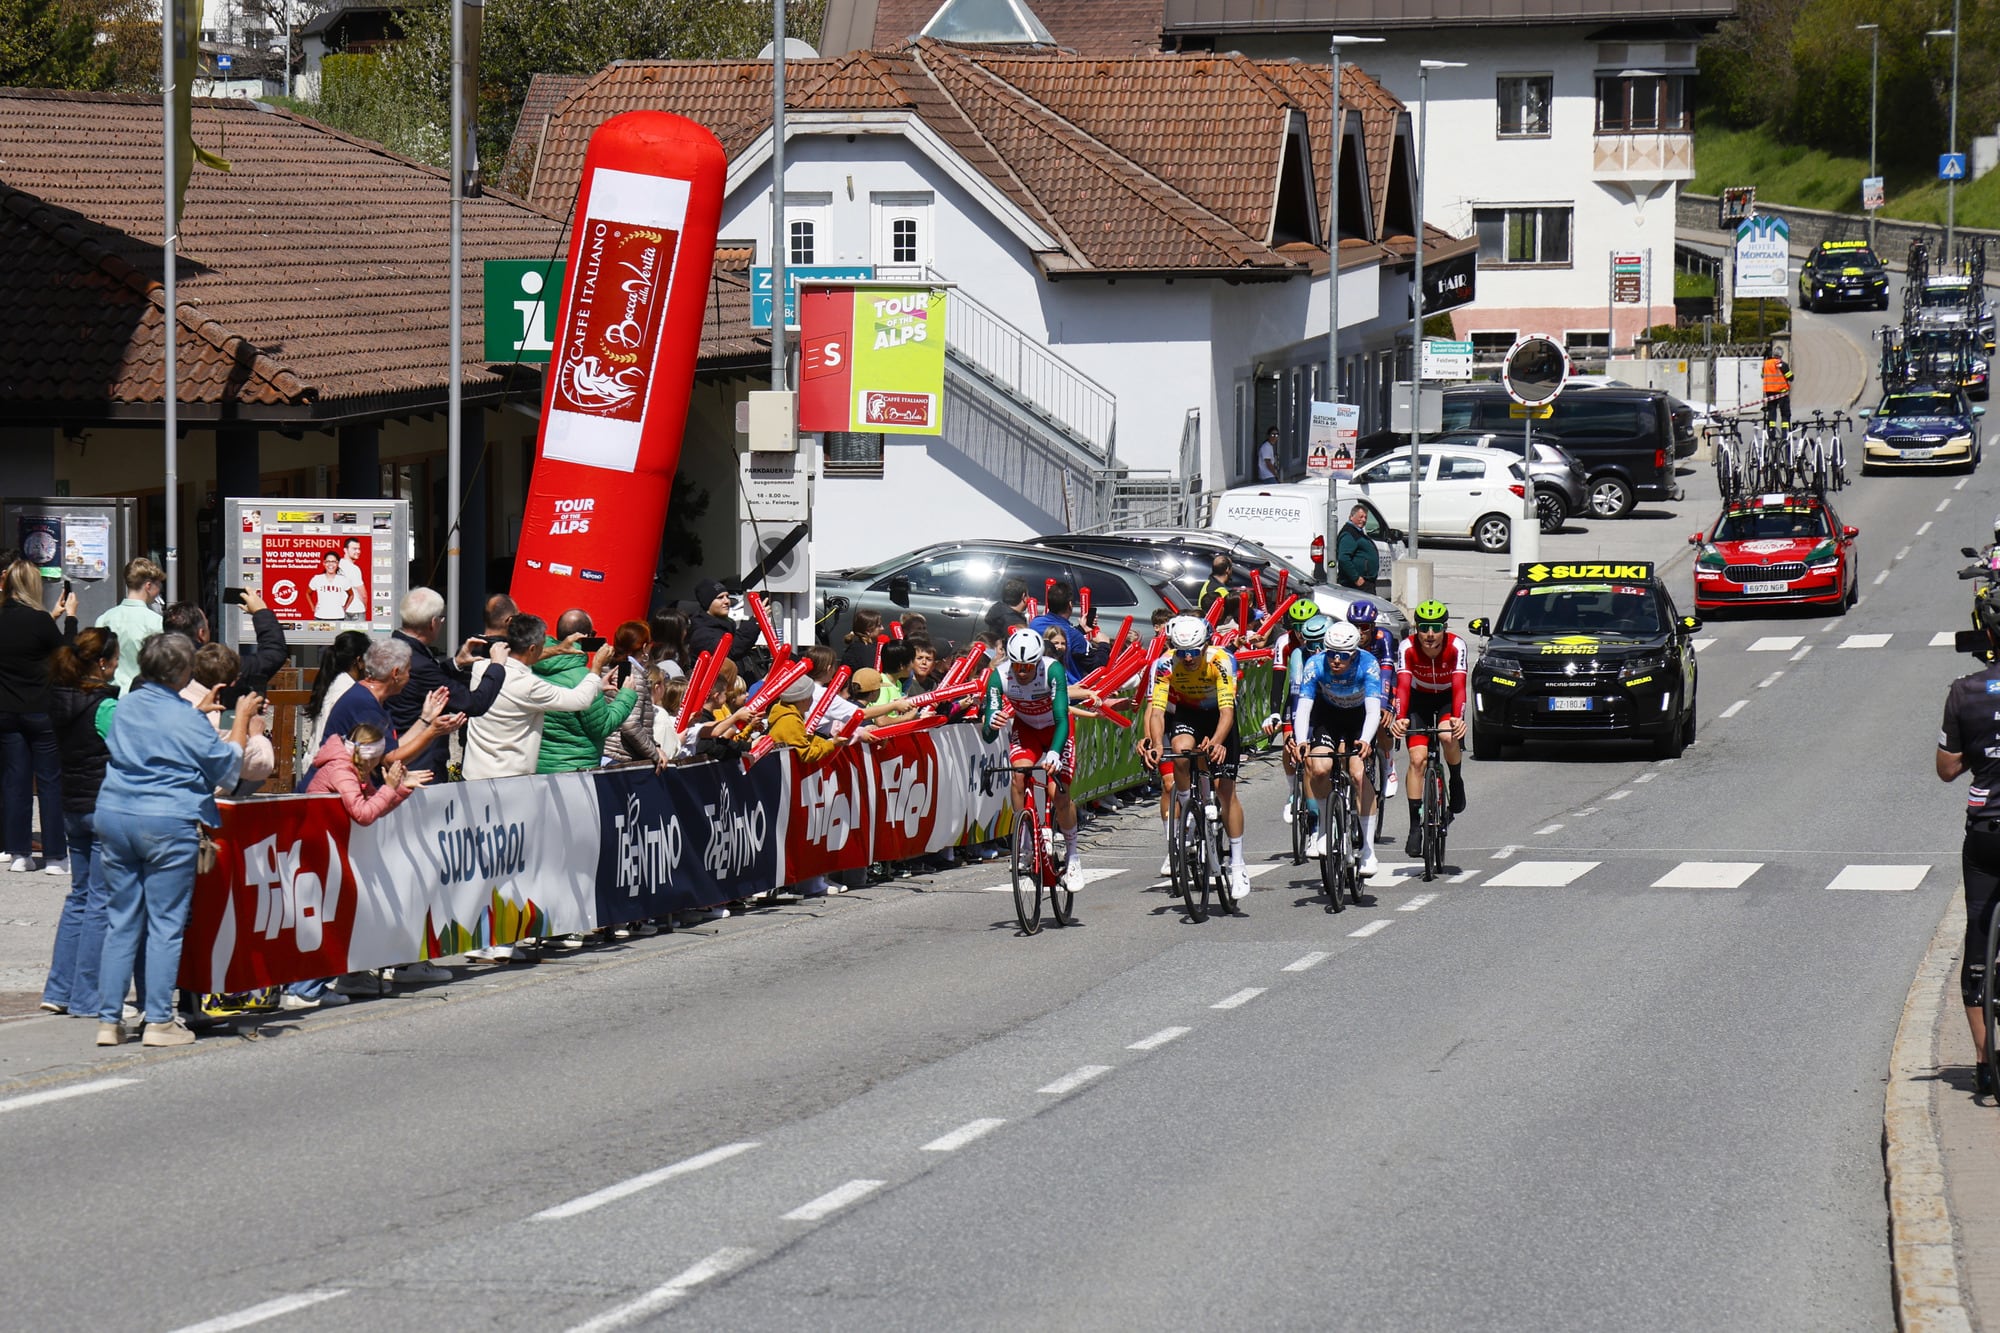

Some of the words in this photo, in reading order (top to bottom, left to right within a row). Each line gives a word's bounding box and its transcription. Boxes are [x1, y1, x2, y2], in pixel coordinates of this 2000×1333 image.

[1740, 251, 1785, 259] MONTANA
[618, 247, 656, 292] Verità
[570, 308, 590, 360] CAFFÈ
[580, 224, 607, 304] ITALIANO
[638, 287, 649, 304] della
[874, 293, 929, 318] TOUR
[605, 292, 642, 348] Bocca
[887, 318, 898, 327] OF
[900, 315, 913, 325] THE
[874, 323, 926, 350] ALPS
[824, 343, 840, 366] S
[555, 498, 595, 512] TOUR
[1228, 506, 1300, 517] KATZENBERGER
[549, 520, 589, 535] ALPS
[265, 538, 291, 548] BLUT
[293, 538, 340, 548] SPENDEN
[1552, 566, 1646, 578] SUZUKI
[1749, 585, 1769, 593] 6970
[1770, 583, 1785, 591] NGR
[1492, 676, 1517, 687] SUZUKI
[1626, 676, 1653, 687] SUZUKI
[880, 757, 933, 838] Tirol
[800, 765, 860, 852] Tirol
[704, 800, 766, 880] TRENTINO
[614, 812, 682, 897] TRENTINO
[245, 830, 342, 952] Tirol
